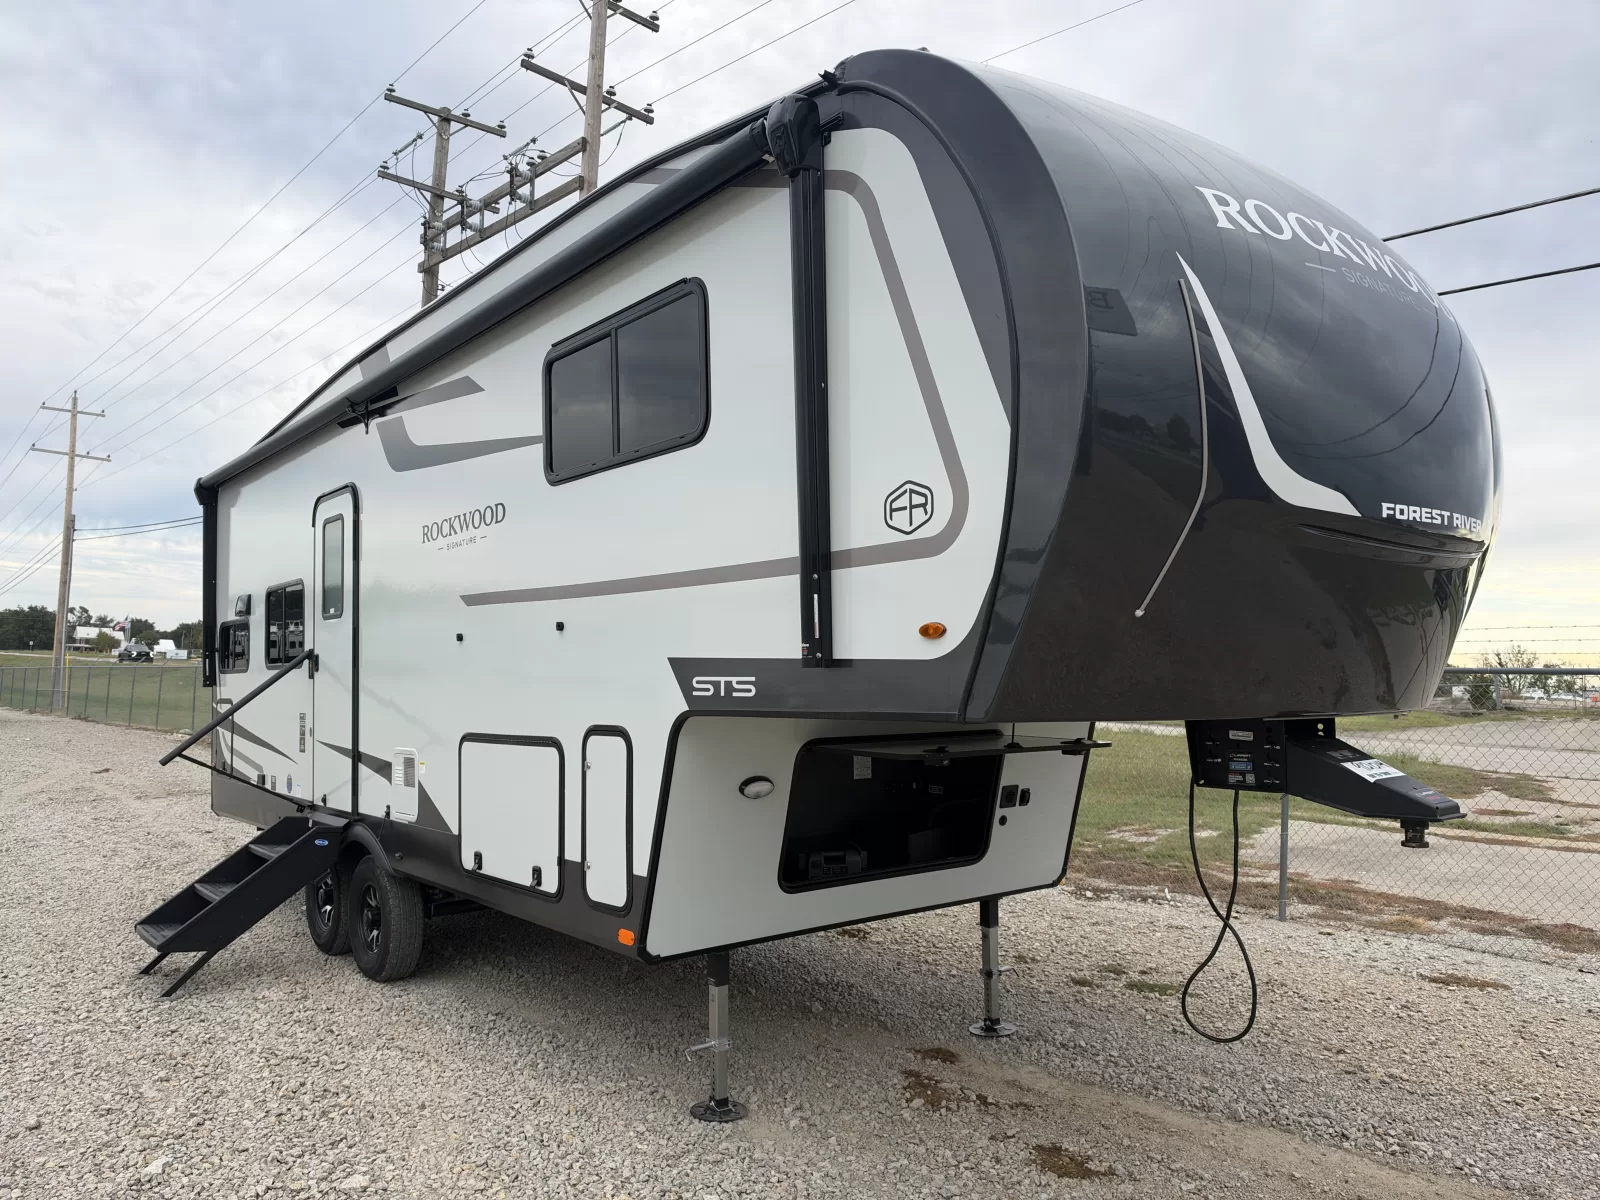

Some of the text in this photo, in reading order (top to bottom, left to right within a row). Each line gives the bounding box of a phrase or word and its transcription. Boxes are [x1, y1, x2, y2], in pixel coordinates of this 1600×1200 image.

[1341, 267, 1421, 311] SIGNATURE
[422, 502, 506, 544] ROCKWOOD
[1381, 502, 1482, 532] FOREST RIVER
[446, 536, 477, 551] SIGNATURE
[692, 676, 756, 697] STS
